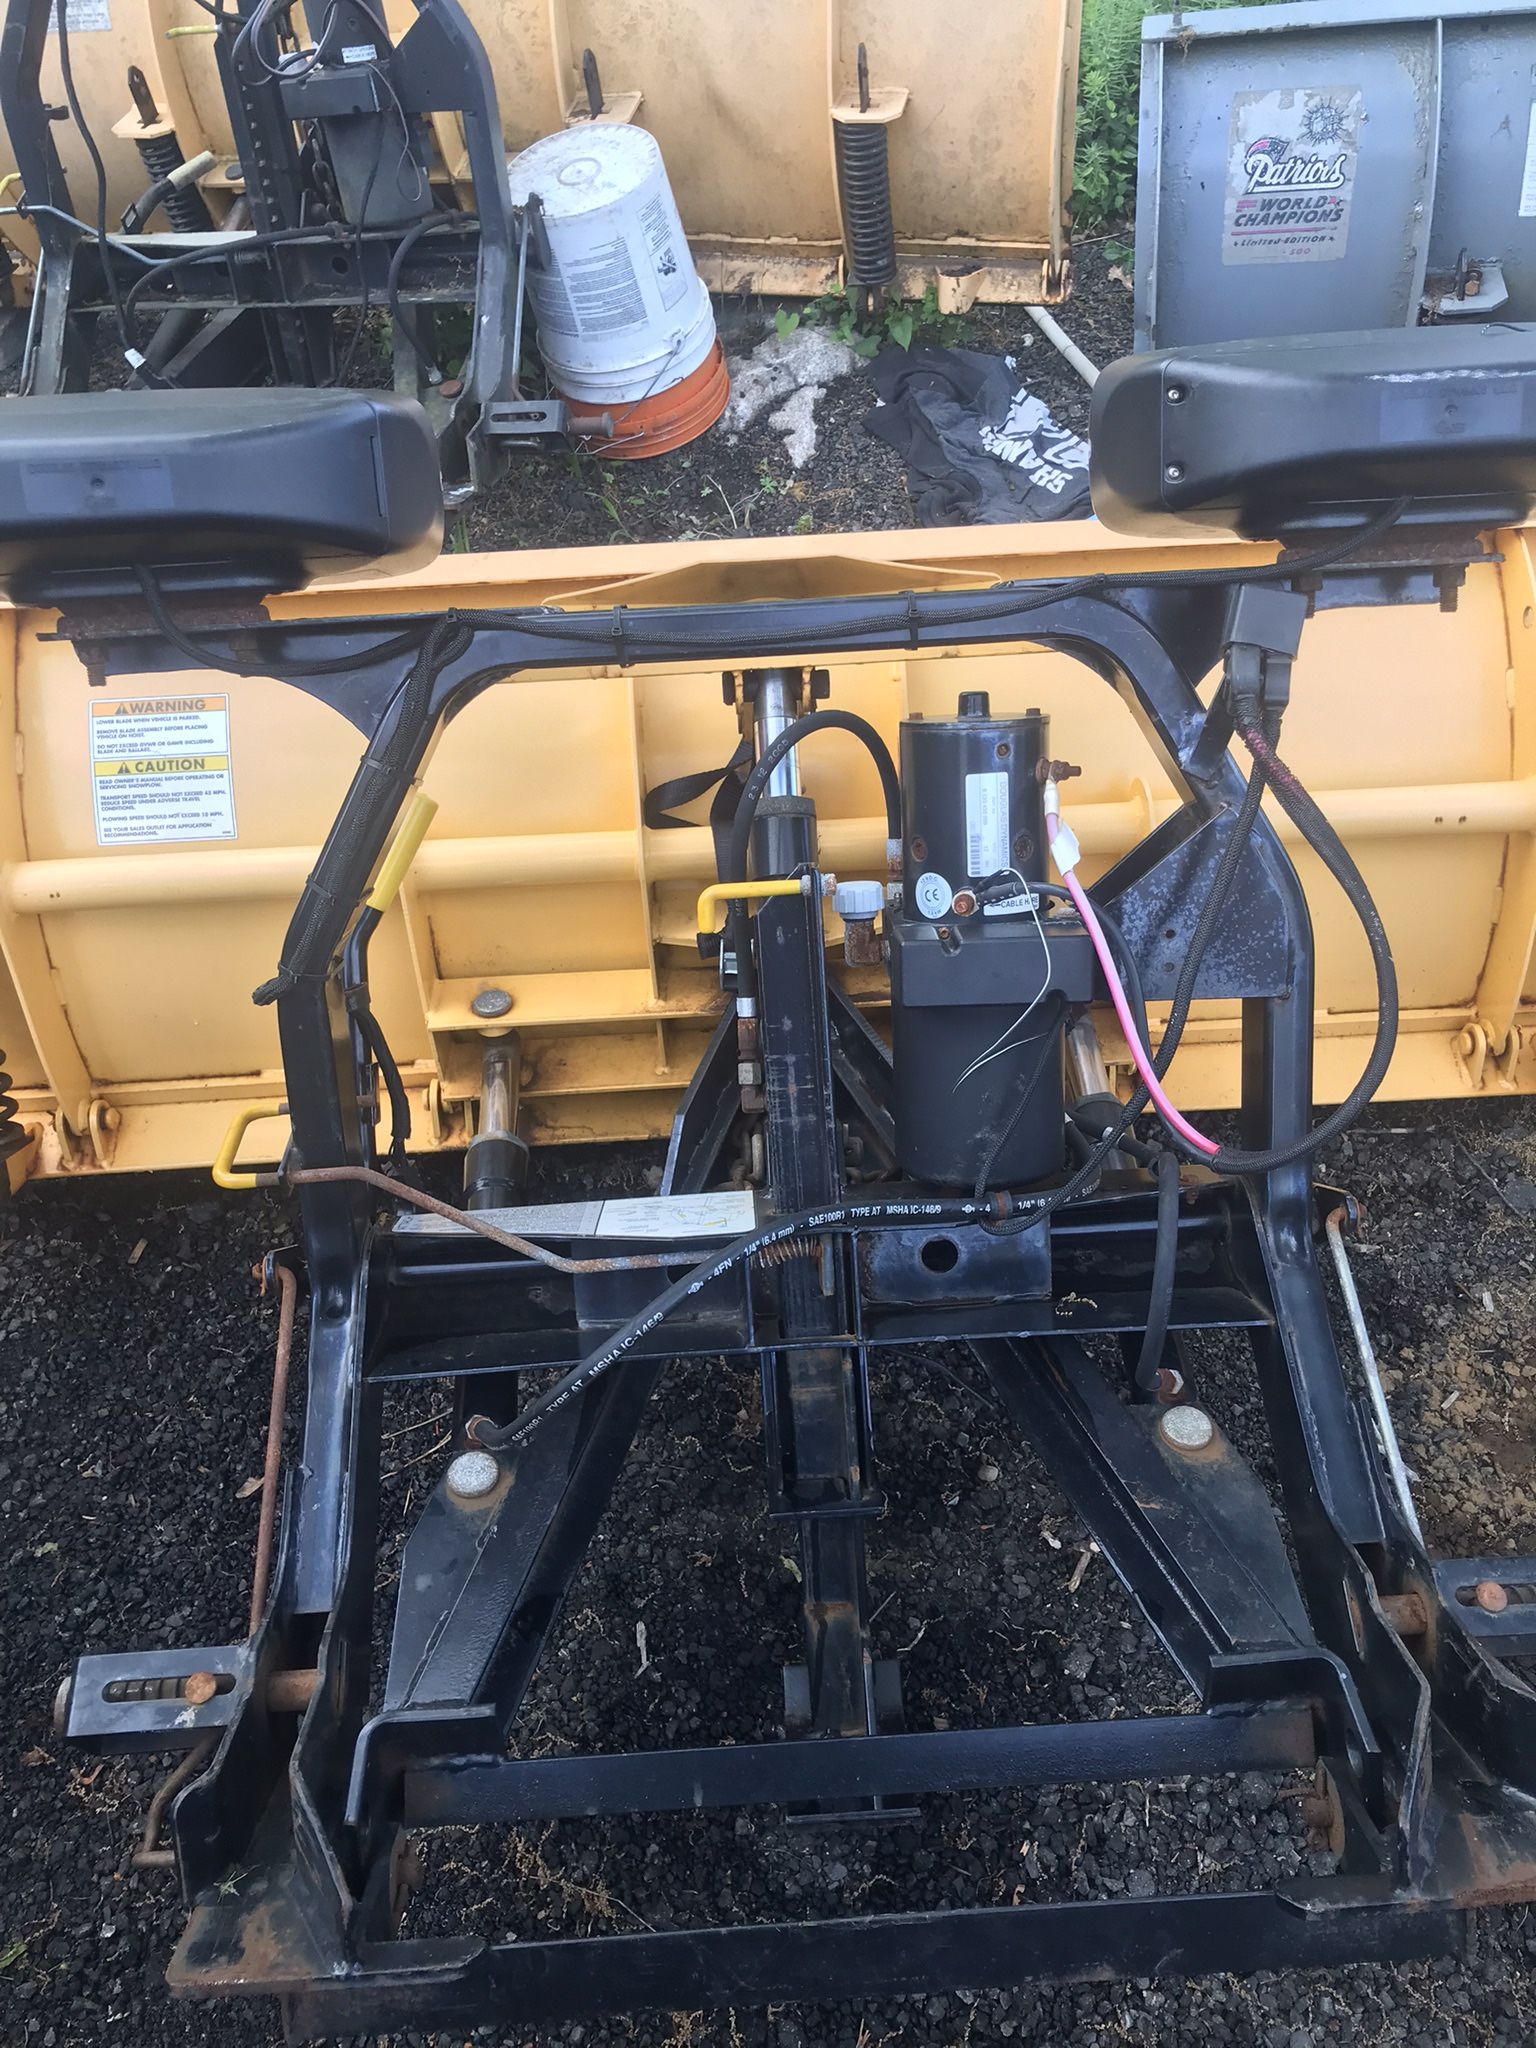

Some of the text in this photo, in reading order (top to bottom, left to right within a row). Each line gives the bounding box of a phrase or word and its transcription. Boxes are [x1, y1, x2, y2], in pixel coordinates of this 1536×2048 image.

[1260, 195, 1327, 211] WORLD
[1234, 208, 1344, 228] CHAMPIONS
[130, 699, 206, 714] WARNING
[135, 759, 205, 772] CAUTION
[1000, 825, 1009, 868] DYNAMICS
[925, 888, 939, 902] CE
[1001, 899, 1023, 908] CABLE
[851, 1206, 870, 1218] TYPE
[870, 1206, 882, 1216] AT
[886, 1205, 908, 1215] MSHA
[546, 1390, 570, 1413] TYPE
[588, 1349, 621, 1378] MSHA
